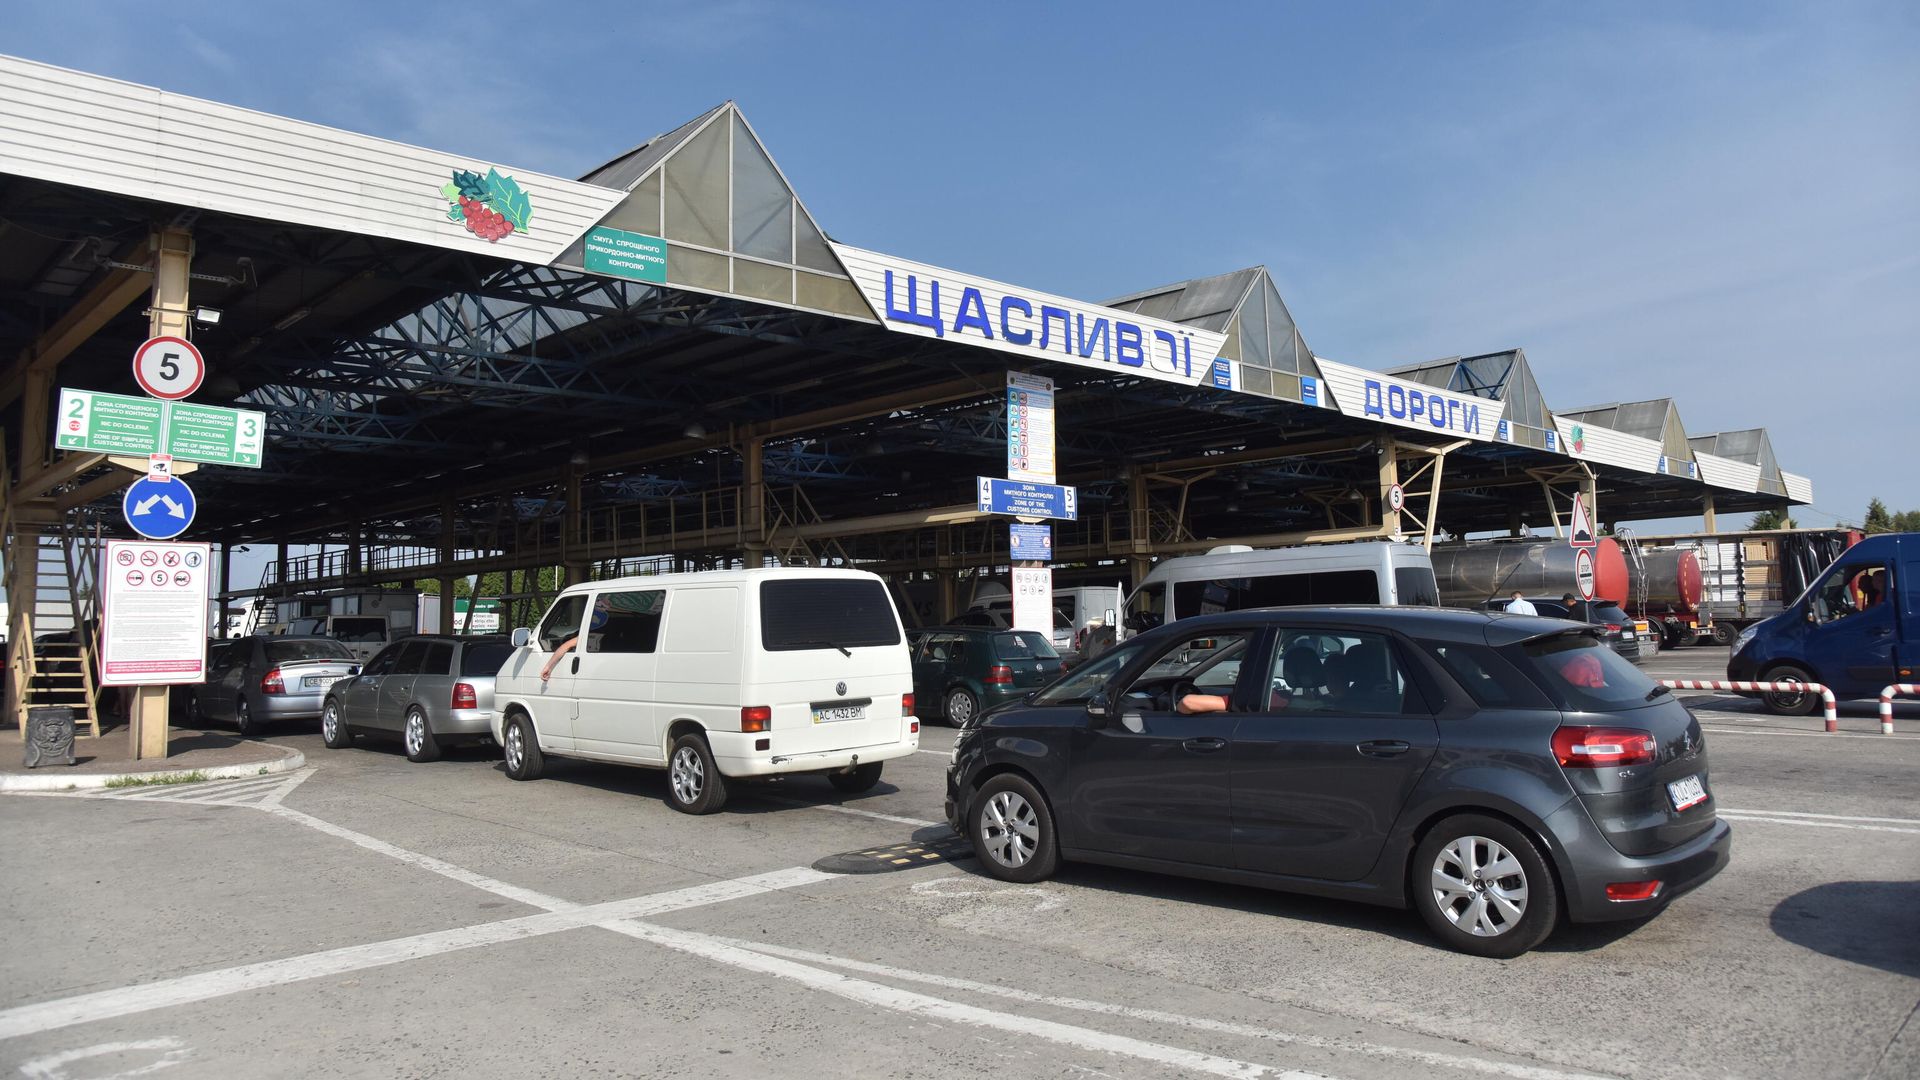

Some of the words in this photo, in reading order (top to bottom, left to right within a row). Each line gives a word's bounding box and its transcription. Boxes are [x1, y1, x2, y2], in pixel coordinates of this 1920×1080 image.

[592, 235, 614, 244] СМУГА
[616, 240, 660, 253] СПРОЩЕНОГО
[587, 244, 664, 264] ПРИКОРДОННО-МИТНОГО
[608, 258, 644, 270] КОНТРОЛЮ
[160, 352, 179, 380] 5
[68, 398, 84, 418] 2
[1364, 379, 1480, 435] ДОРОГИ
[244, 418, 256, 437] 3
[983, 481, 990, 493] 4
[1066, 490, 1072, 501] 5
[1394, 491, 1399, 503] 5
[157, 574, 162, 583] 5
[820, 710, 830, 720] AC
[832, 708, 849, 719] 1432
[850, 707, 862, 718] BM
